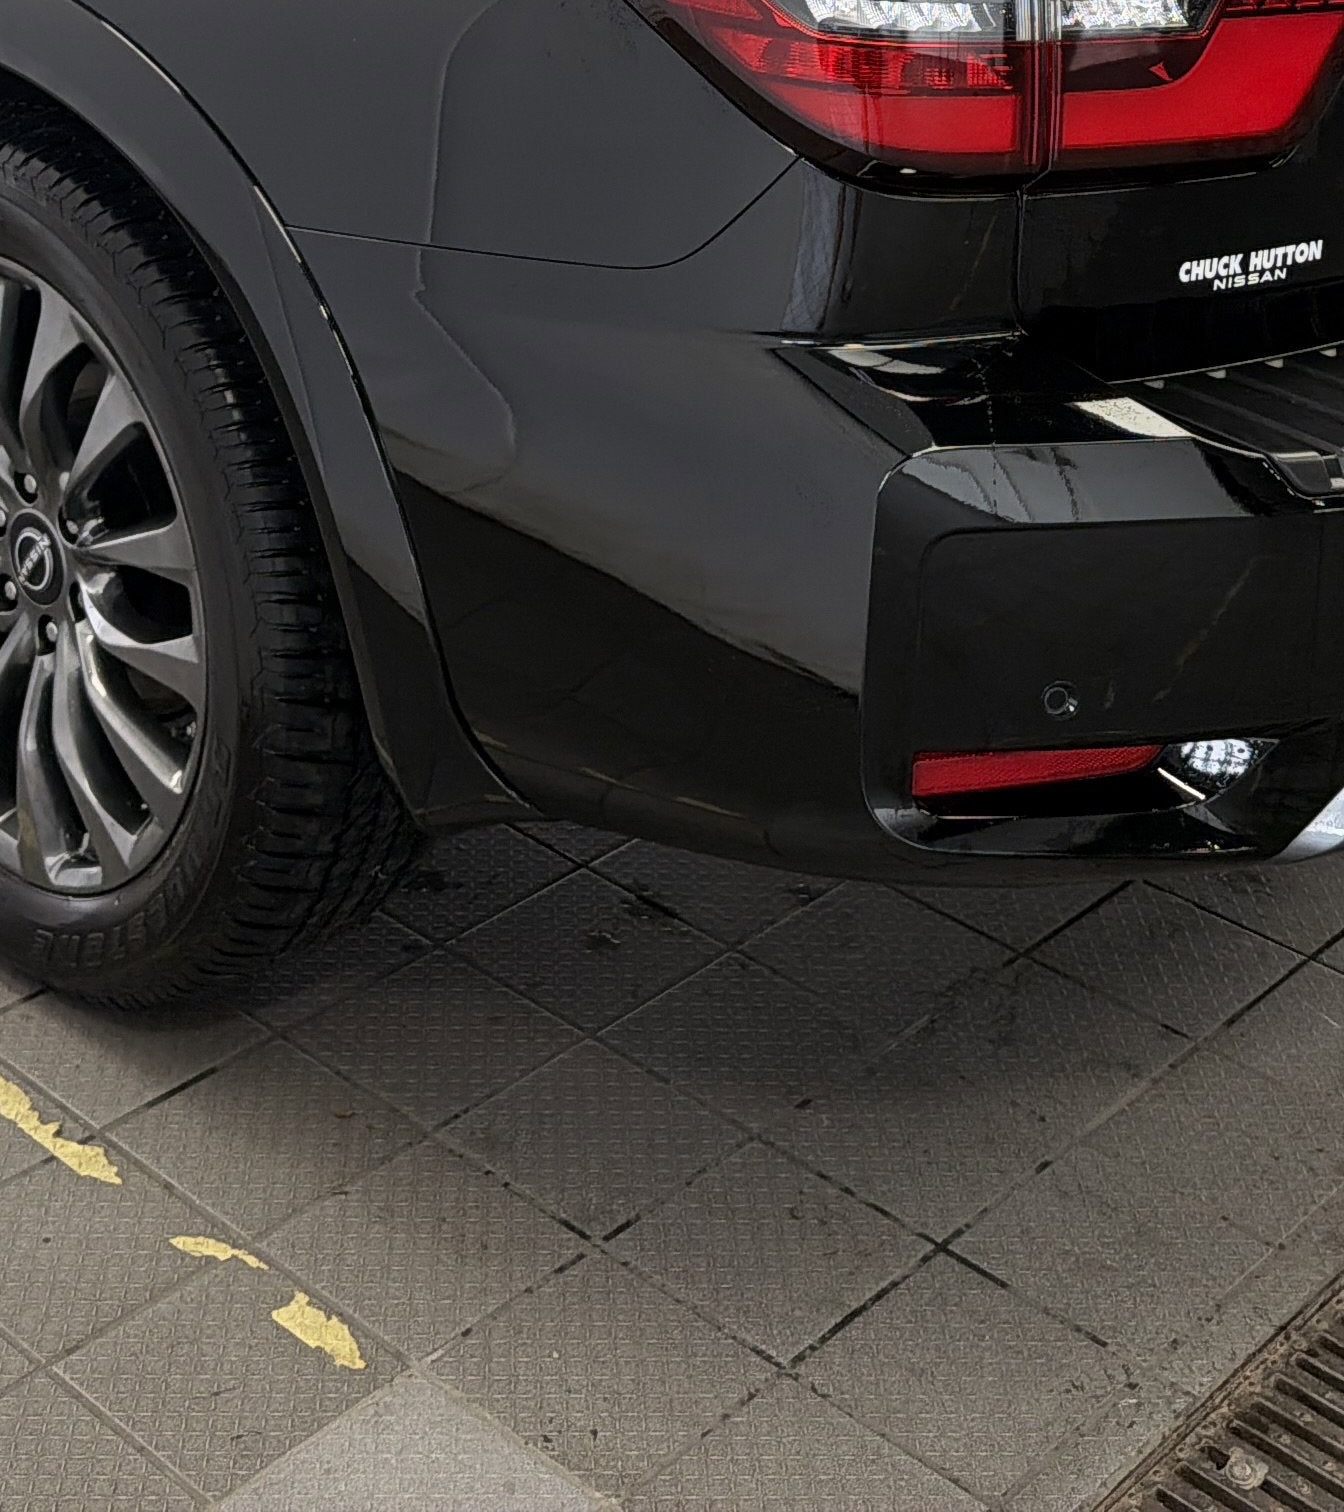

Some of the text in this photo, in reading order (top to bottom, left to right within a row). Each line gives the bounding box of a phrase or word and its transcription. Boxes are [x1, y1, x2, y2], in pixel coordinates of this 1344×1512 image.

[1178, 239, 1324, 283] CHUCK HUTTON
[1212, 267, 1287, 292] NISSAN
